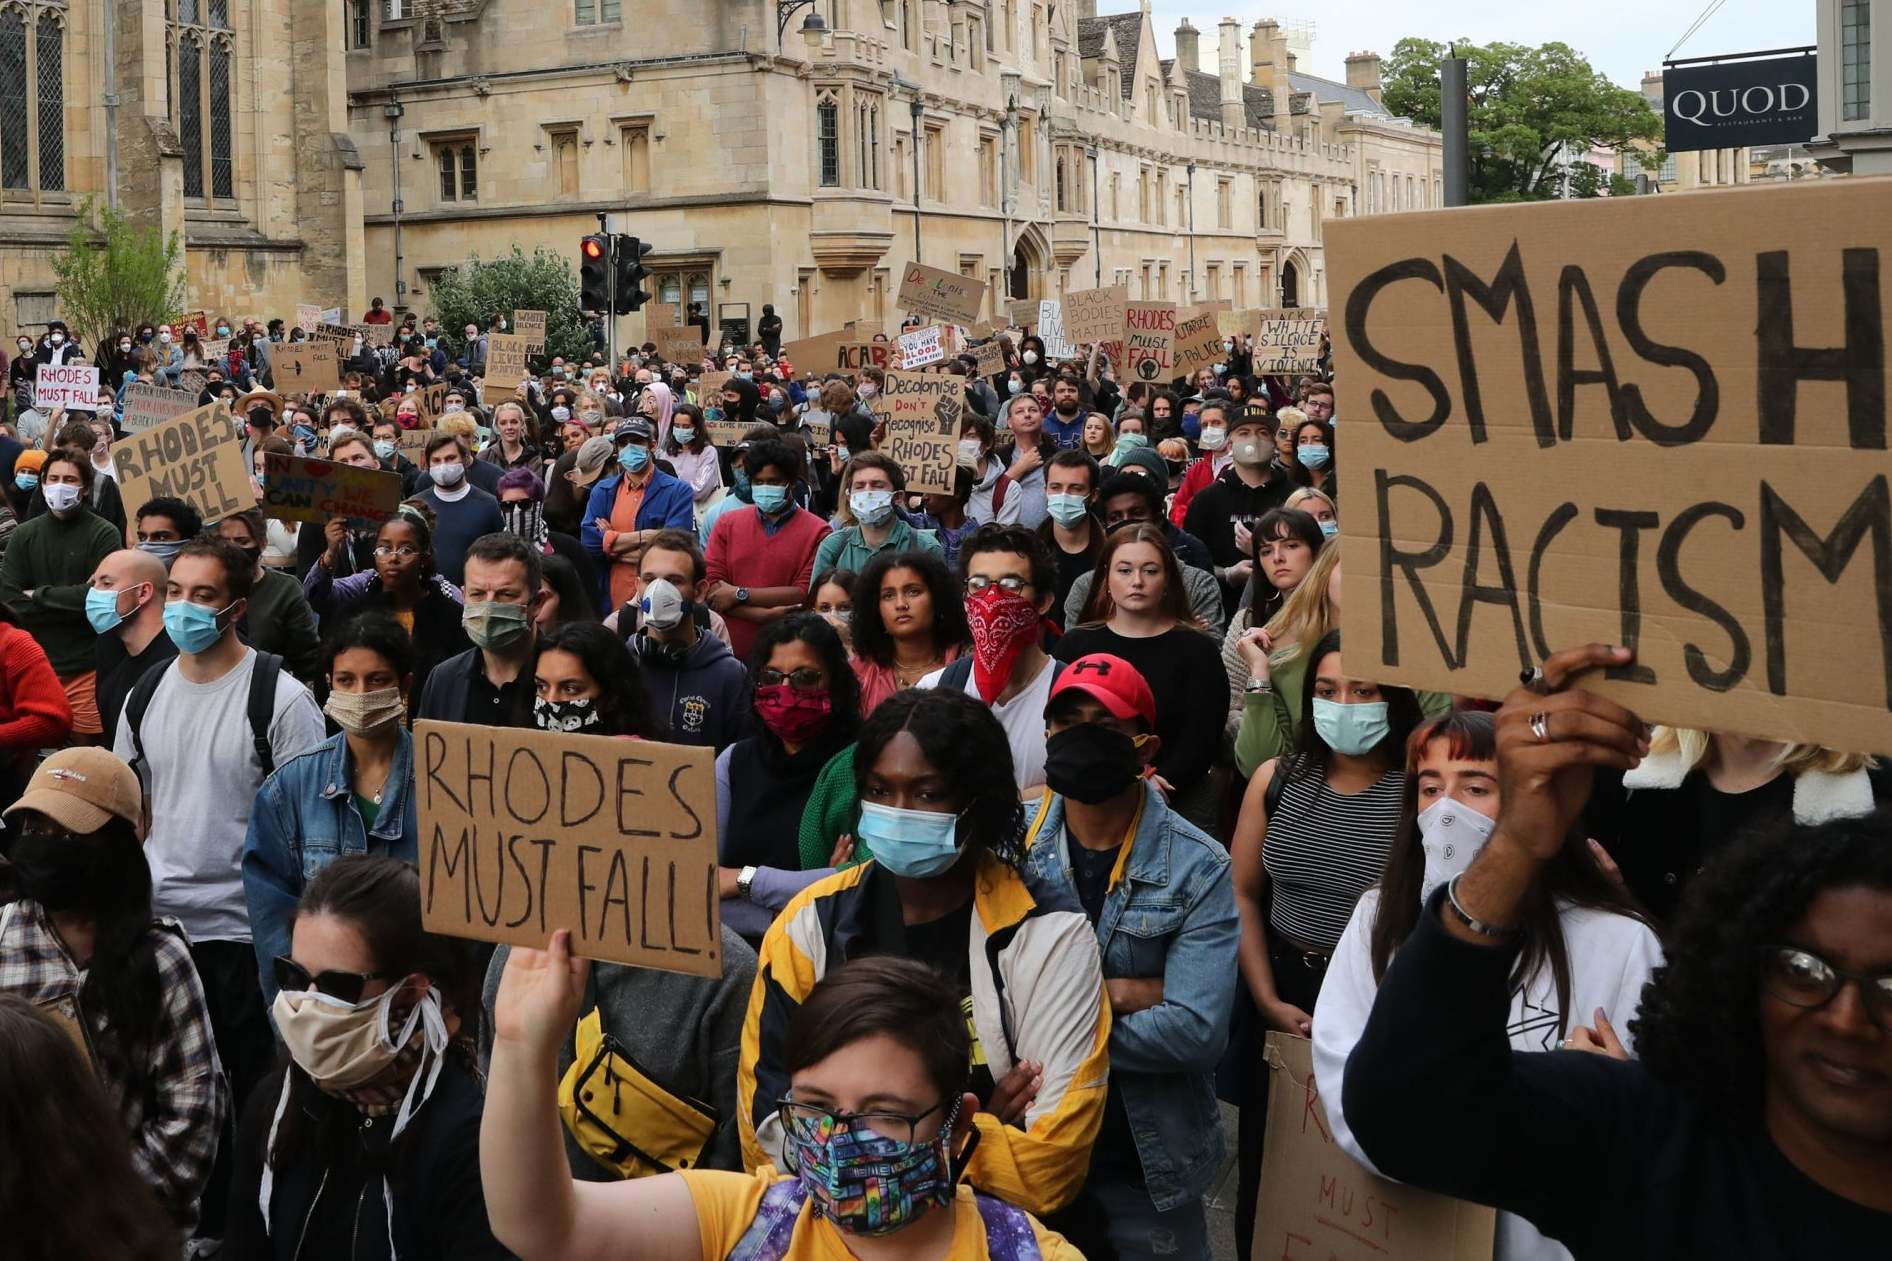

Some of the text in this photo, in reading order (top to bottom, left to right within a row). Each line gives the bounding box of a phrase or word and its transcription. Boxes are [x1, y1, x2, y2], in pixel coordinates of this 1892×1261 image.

[1672, 83, 1810, 126] QUOD
[1717, 118, 1773, 127] RESTAURANT
[1067, 290, 1112, 308] BLACK
[518, 312, 544, 322] WHITE
[1070, 304, 1124, 323] BODIES
[1127, 308, 1175, 331] RHODES
[316, 323, 357, 338] #RHODES
[1071, 322, 1120, 340] MATTE
[1267, 320, 1322, 335] WHITE
[275, 344, 304, 353] RHODES
[492, 339, 524, 353] BLACK
[525, 343, 544, 354] BLM
[904, 335, 937, 352] YOU HAVE
[1260, 333, 1318, 347] SILENCE
[1345, 237, 1887, 450] SMASH
[312, 353, 328, 362] FALL
[491, 352, 524, 365] LIVES
[837, 345, 887, 369] ACAB
[905, 345, 937, 360] BLOOD
[915, 356, 928, 365] YOUR
[1127, 348, 1170, 369] FALL
[1184, 339, 1224, 366] POLICE
[1281, 346, 1298, 359] IS
[41, 368, 91, 385] RHODES
[885, 374, 959, 396] Decolonise
[38, 388, 97, 405] MUST FALL
[895, 397, 927, 412] DON'T
[113, 403, 236, 484] RHODES
[148, 451, 218, 499] MUST
[921, 463, 951, 491] FALL
[186, 481, 239, 518] ALL
[267, 489, 312, 508] CAN
[1374, 468, 1892, 713] RACISM
[425, 731, 702, 840] RHODES
[427, 822, 716, 960] MUST FALL!
[1318, 1174, 1399, 1241] MUST
